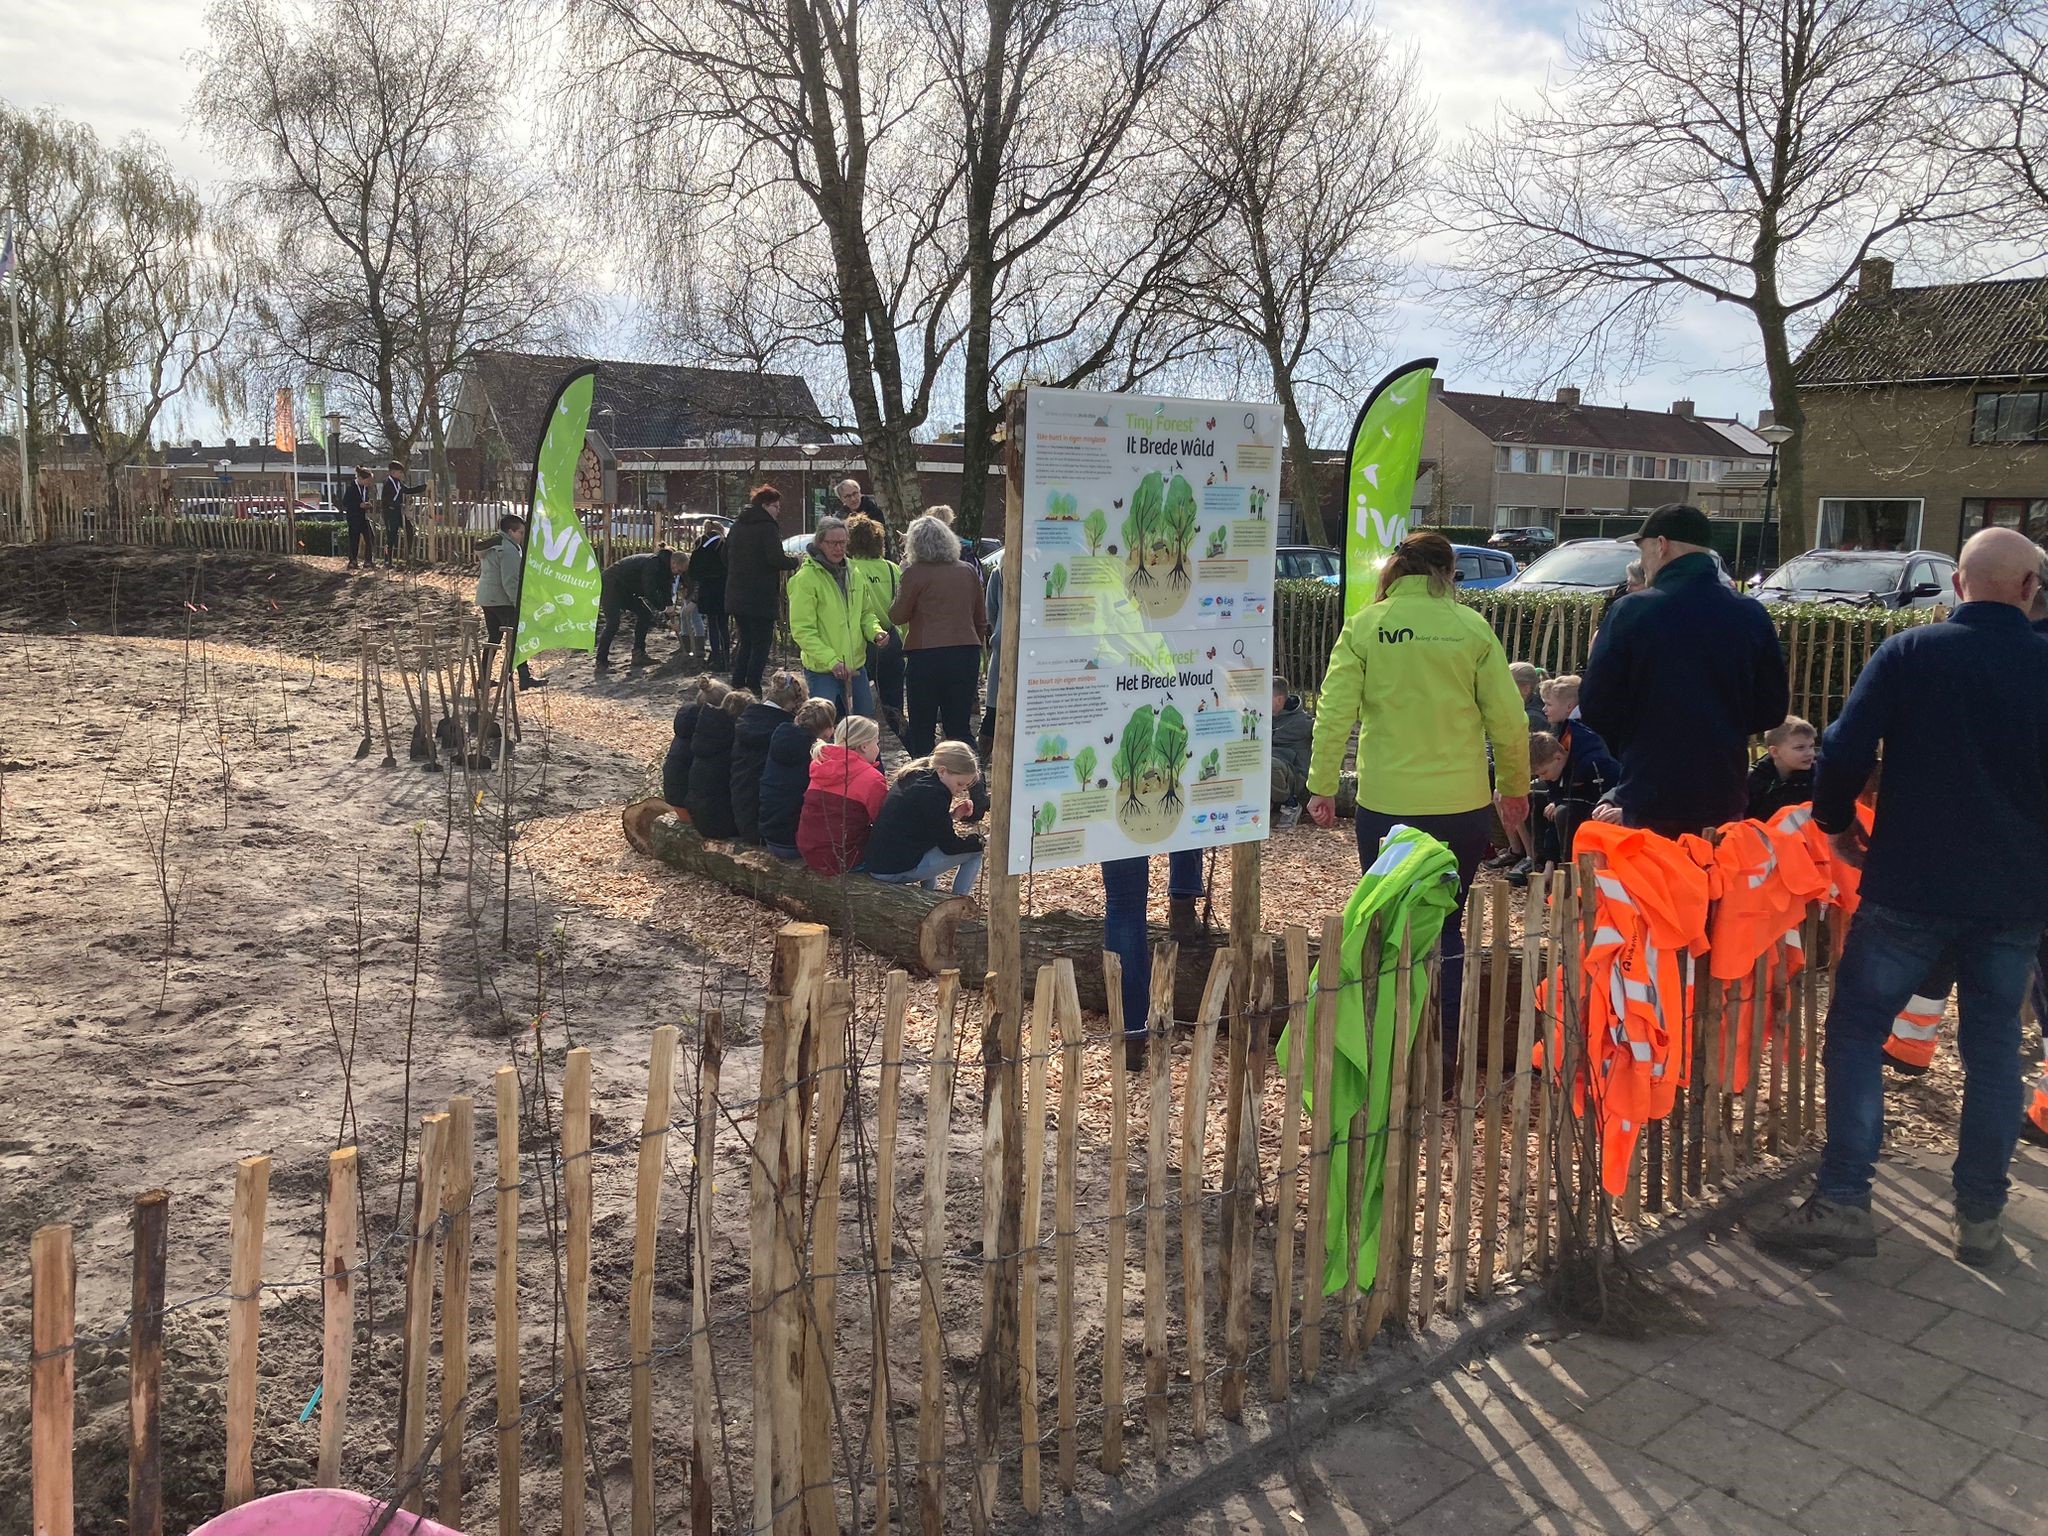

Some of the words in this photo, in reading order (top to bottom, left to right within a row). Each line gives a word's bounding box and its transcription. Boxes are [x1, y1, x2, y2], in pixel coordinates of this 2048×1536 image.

[1126, 413, 1153, 436] Tiny
[1127, 436, 1137, 454] It
[1140, 437, 1178, 456] Brede
[1181, 437, 1214, 457] Wâld
[543, 564, 553, 577] de
[555, 571, 597, 590] natuur!
[1378, 626, 1414, 644] ivn
[1128, 652, 1154, 672] Tiny
[1116, 675, 1138, 691] Het
[1141, 672, 1177, 690] Brede
[1179, 669, 1213, 687] Woud
